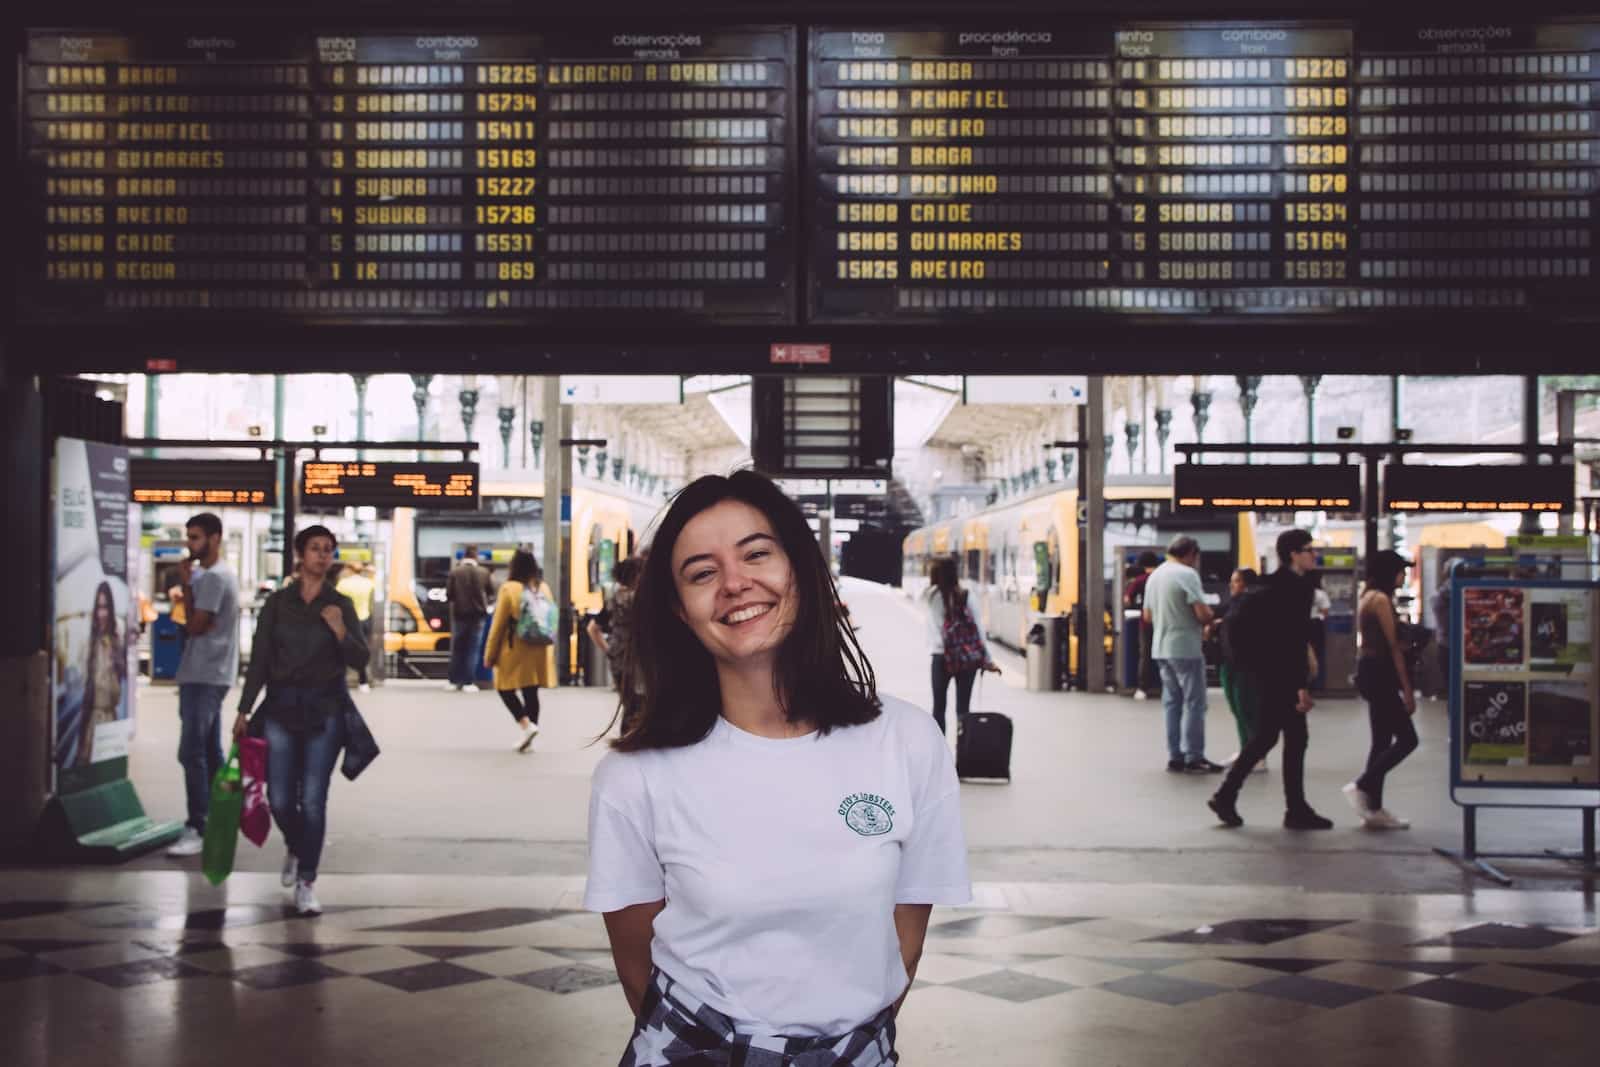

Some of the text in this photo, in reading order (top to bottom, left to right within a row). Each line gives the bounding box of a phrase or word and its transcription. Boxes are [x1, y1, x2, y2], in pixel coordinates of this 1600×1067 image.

[415, 36, 479, 49] comboio
[612, 33, 702, 48] observações
[852, 31, 884, 44] hora
[959, 31, 1052, 46] procedência
[1221, 29, 1288, 41] comboio
[1418, 25, 1512, 40] observações
[991, 45, 1019, 56] from
[548, 64, 632, 85] LIGACAO
[910, 62, 973, 80] BRAGA
[476, 94, 537, 113] 15734
[910, 90, 1009, 109] PENAFIEL
[117, 122, 211, 141] PENAFIEL
[476, 122, 537, 141] 15411
[910, 118, 985, 137] AVEIRO
[117, 150, 224, 169] GUIMARAES
[476, 150, 537, 169] 15163
[910, 147, 973, 166] BRAGA
[117, 178, 176, 196] BRAGA
[356, 178, 427, 197] SUBURB
[476, 178, 537, 197] 15227
[910, 175, 998, 194] POCINHO
[117, 206, 188, 224] AVEIRO
[356, 206, 427, 224] SUBURB
[476, 206, 537, 224] 15736
[837, 203, 1348, 222] 15H00 CAIDE 2 SUBURB 15534
[117, 234, 174, 252] CAIDE
[476, 234, 537, 252] 15531
[837, 231, 1348, 251] 15H05 GUIMARAES 5 SUBURB 15164
[117, 262, 175, 280] REGUA
[356, 262, 378, 280] IR
[498, 262, 537, 280] 869
[837, 260, 898, 279] 15H25
[910, 260, 985, 279] AVEIRO
[1158, 260, 1234, 279] SUBURB
